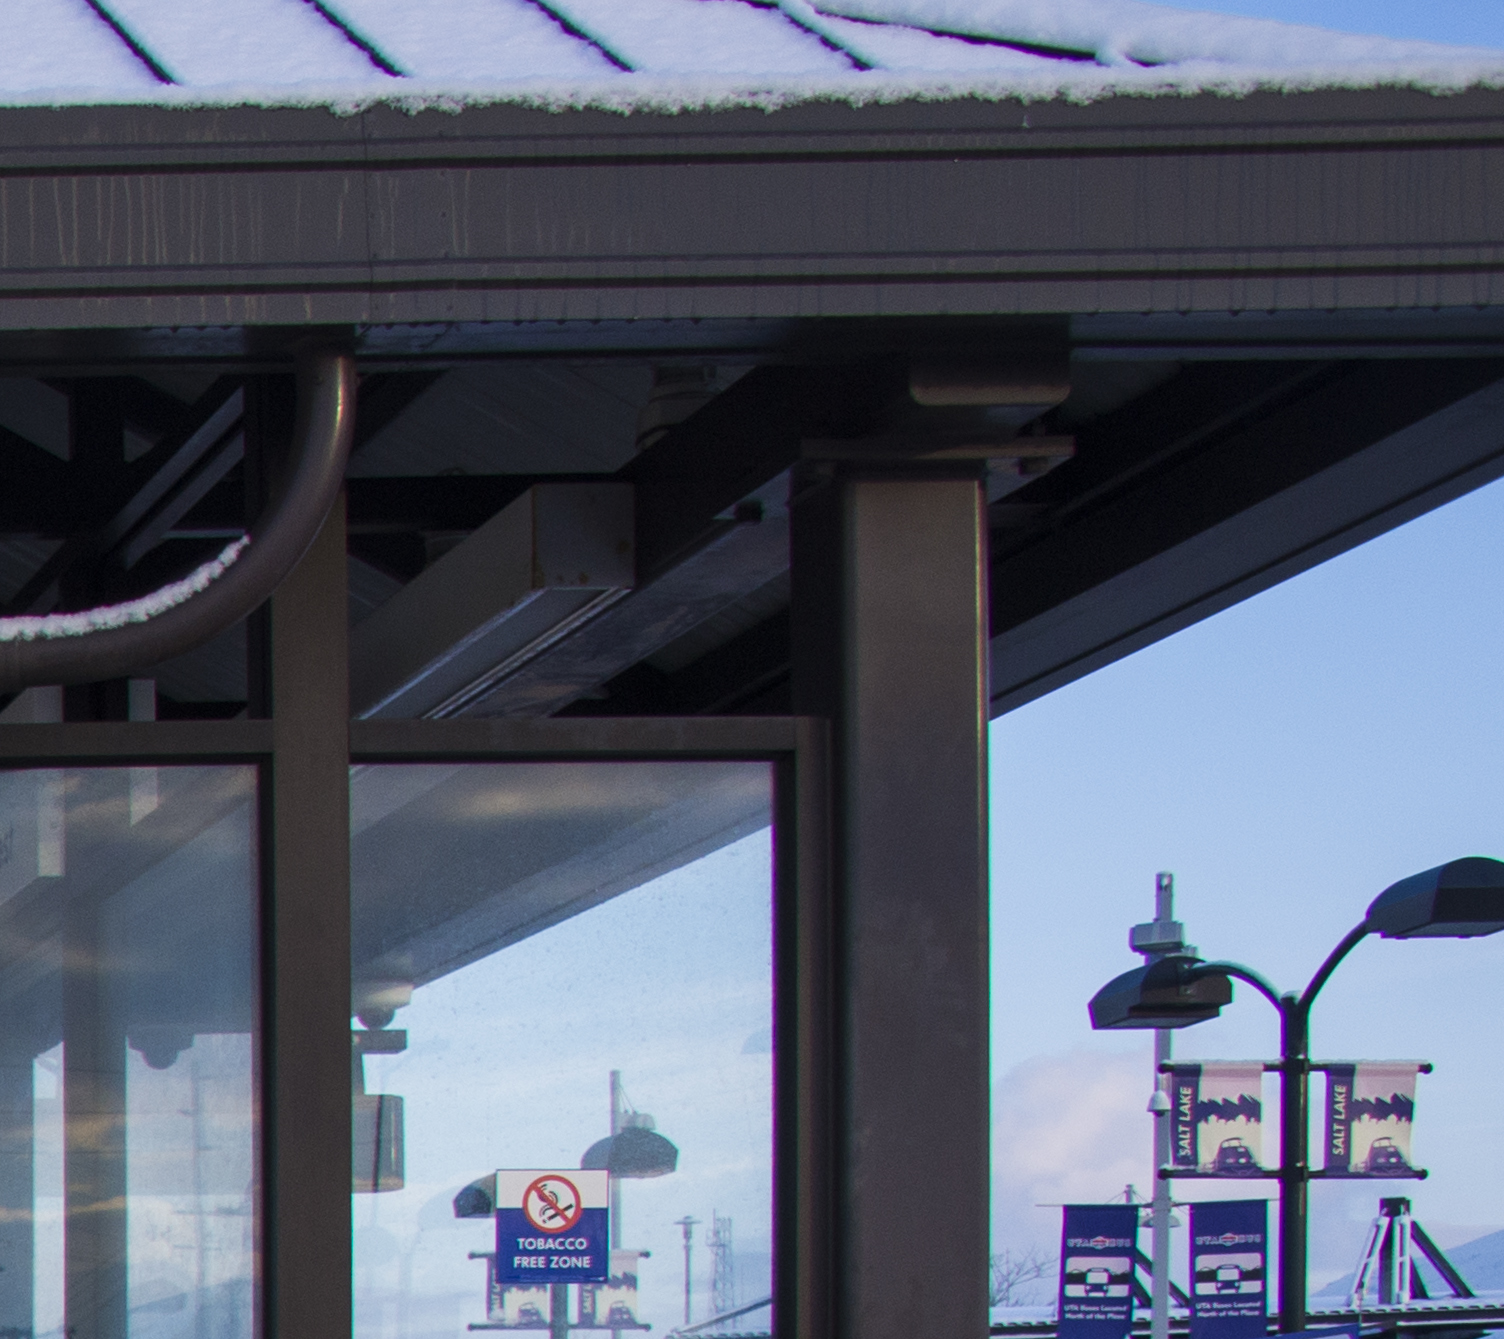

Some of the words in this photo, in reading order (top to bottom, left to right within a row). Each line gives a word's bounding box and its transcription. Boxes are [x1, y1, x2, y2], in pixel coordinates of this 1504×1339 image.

[1179, 1086, 1193, 1121] LAKE
[1333, 1084, 1347, 1121] LAKE
[1179, 1123, 1192, 1157] SALT
[1332, 1123, 1346, 1156] SALT
[516, 1237, 588, 1250] TOBACCO
[513, 1256, 546, 1268] FREE
[549, 1256, 591, 1268] ZONE
